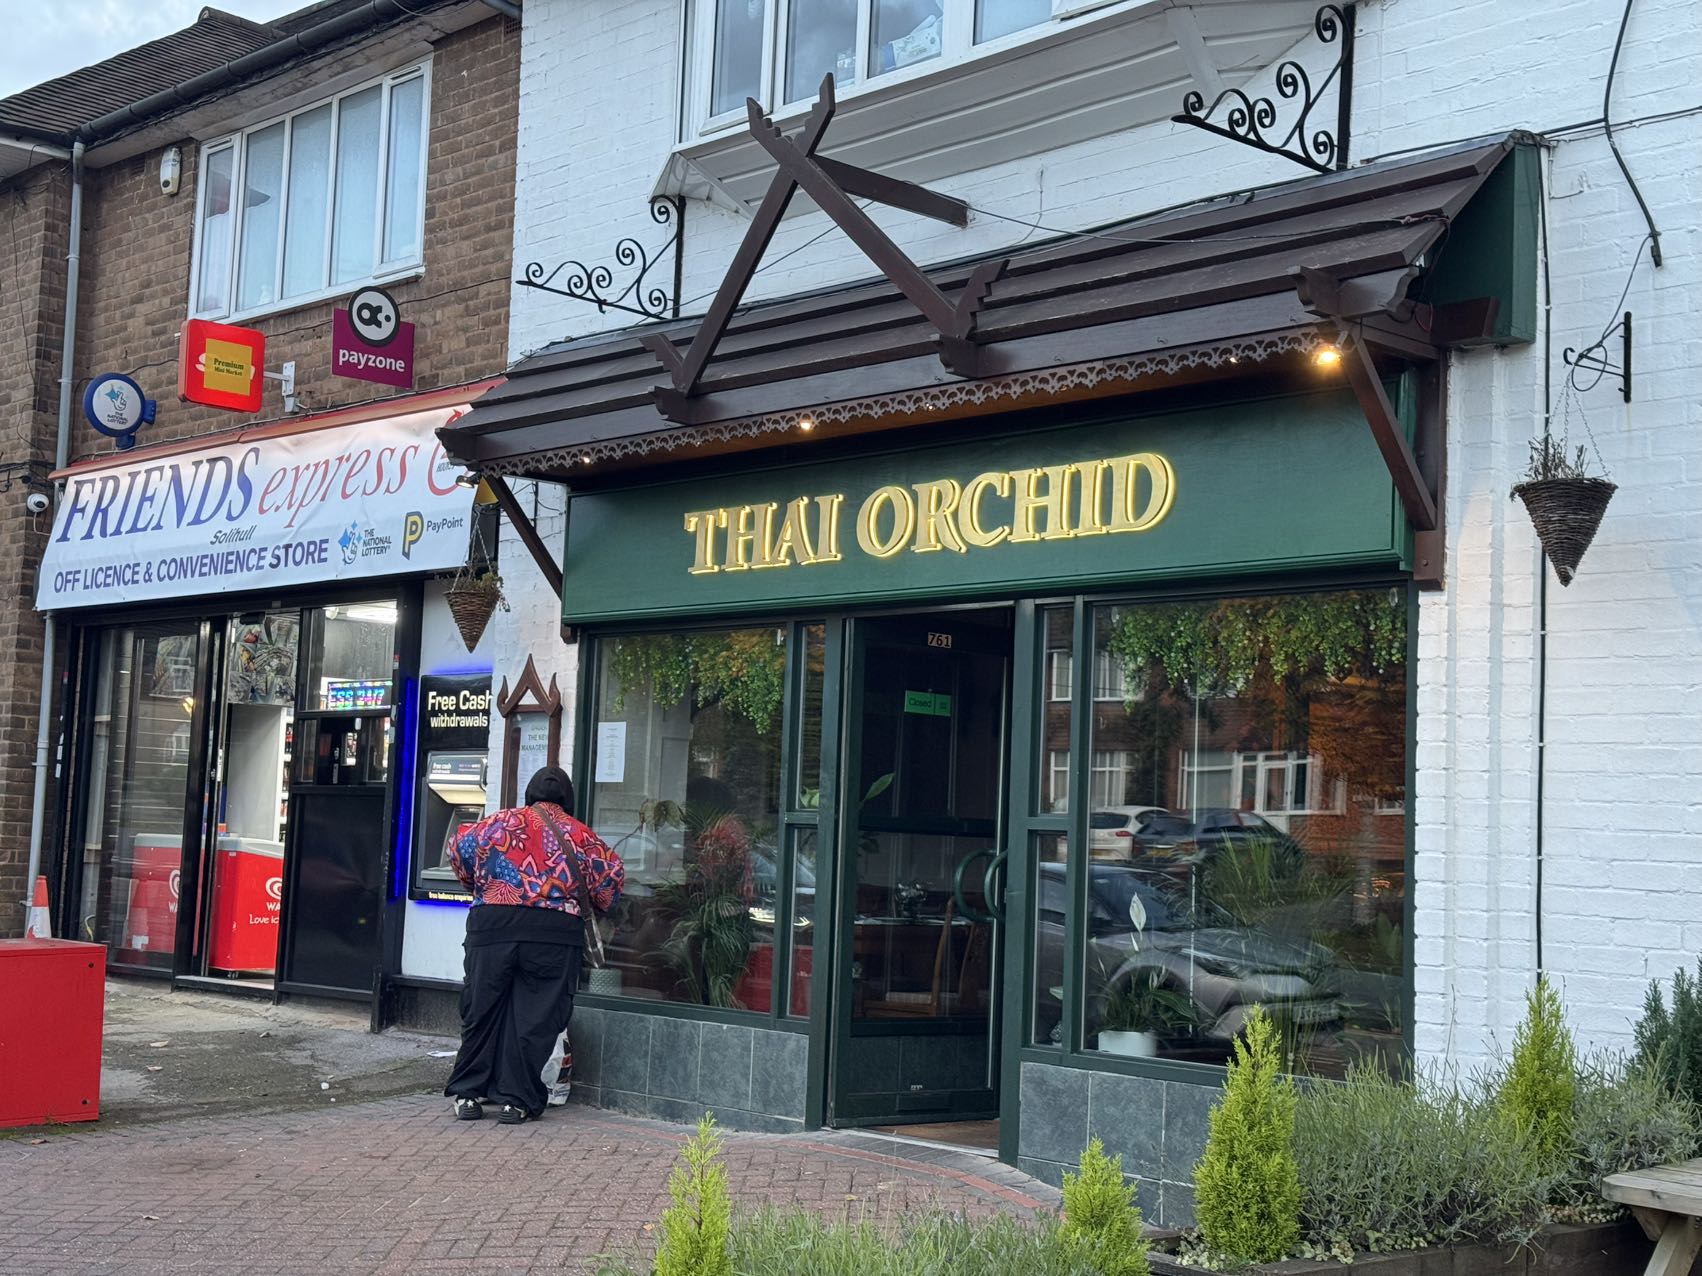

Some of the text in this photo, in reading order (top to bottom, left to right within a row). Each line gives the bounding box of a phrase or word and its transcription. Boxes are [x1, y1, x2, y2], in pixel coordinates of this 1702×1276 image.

[213, 358, 244, 370] Premium
[339, 349, 405, 372] payzone
[55, 444, 420, 543] FRIENDS express
[684, 452, 1176, 575] THAI ORCHID
[363, 528, 375, 538] THE
[426, 517, 464, 534] PayPoint
[209, 525, 257, 545] Solihull
[362, 536, 392, 548] NATIONAL
[54, 538, 329, 593] OFF LICENCE & CONVENIENCE STORE
[928, 633, 951, 648] 761
[428, 691, 456, 711] Free
[430, 712, 488, 728] withdrawals
[249, 913, 269, 925] Love
